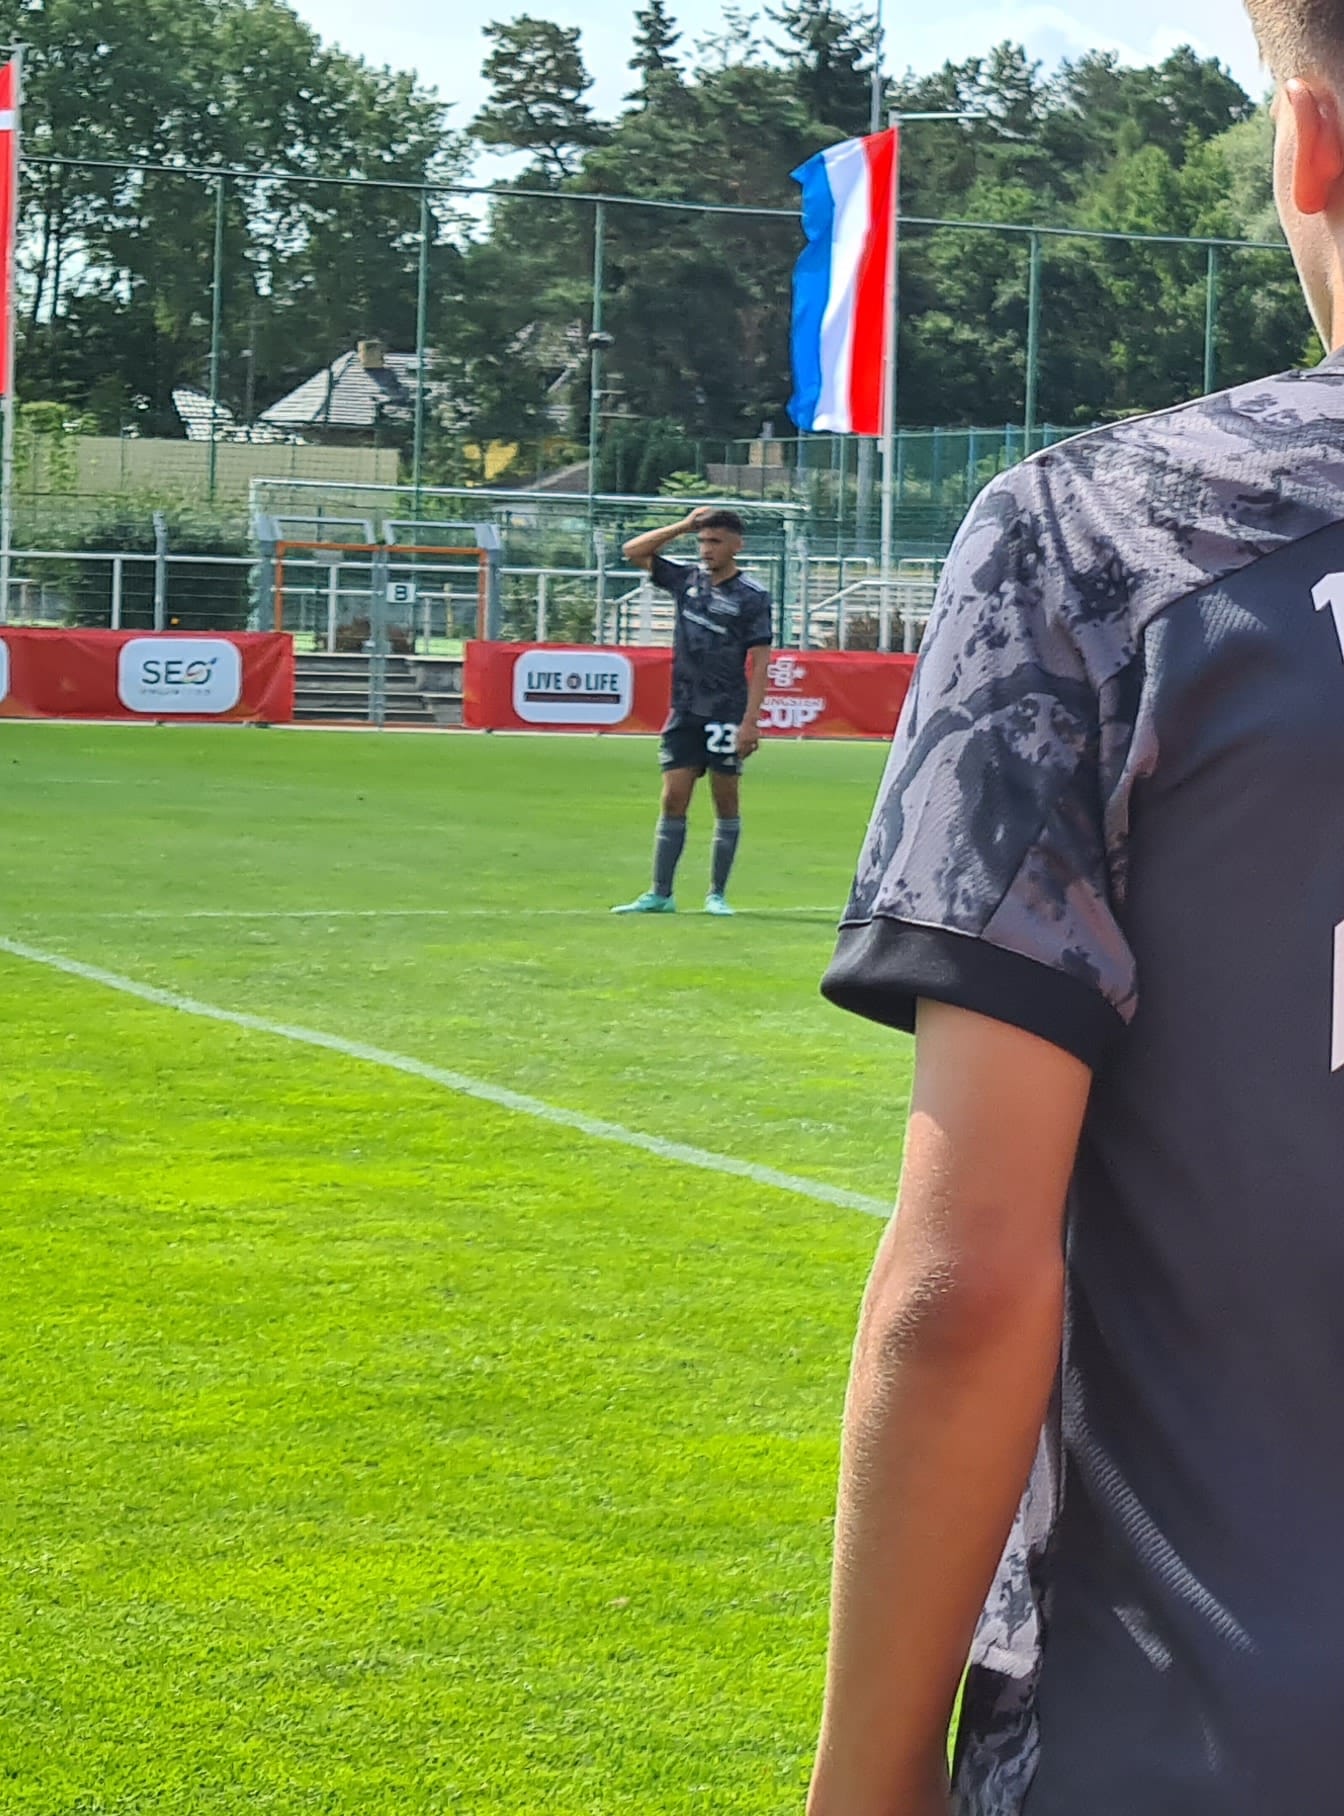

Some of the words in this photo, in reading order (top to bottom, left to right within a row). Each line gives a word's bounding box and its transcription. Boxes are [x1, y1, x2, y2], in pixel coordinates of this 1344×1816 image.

[394, 585, 408, 601] B
[142, 659, 213, 685] SEO
[527, 671, 563, 690] LIVE
[585, 673, 619, 691] LIFE
[704, 723, 738, 754] 23
